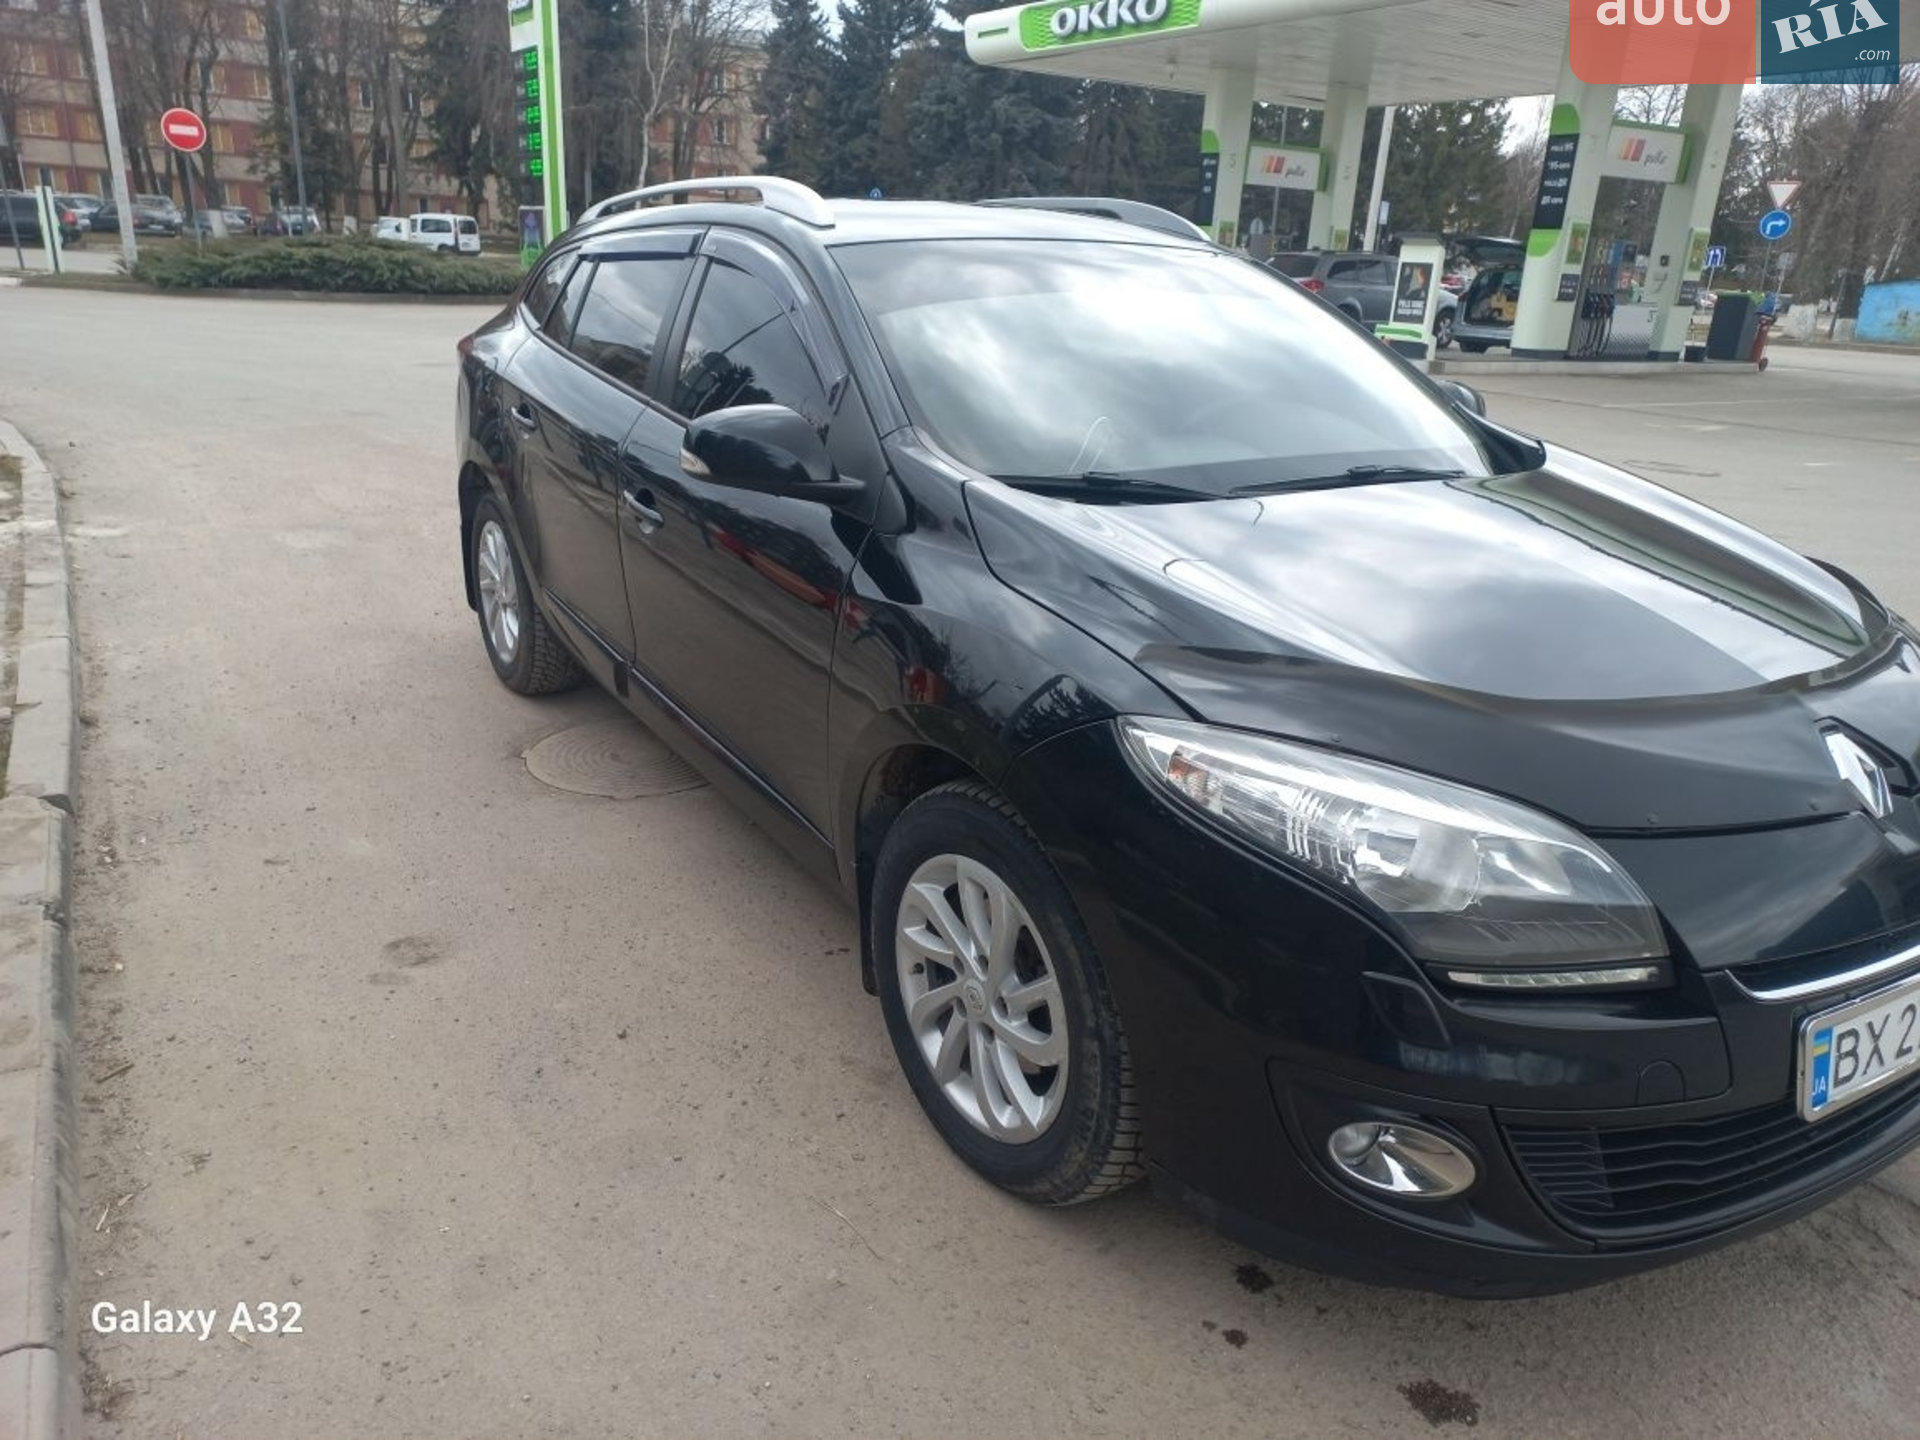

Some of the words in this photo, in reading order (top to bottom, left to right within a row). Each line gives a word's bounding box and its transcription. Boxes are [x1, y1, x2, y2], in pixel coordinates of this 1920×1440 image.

[1050, 0, 1168, 37] OKKO
[1833, 1012, 1891, 1089] BX
[1895, 1003, 1920, 1059] 2
